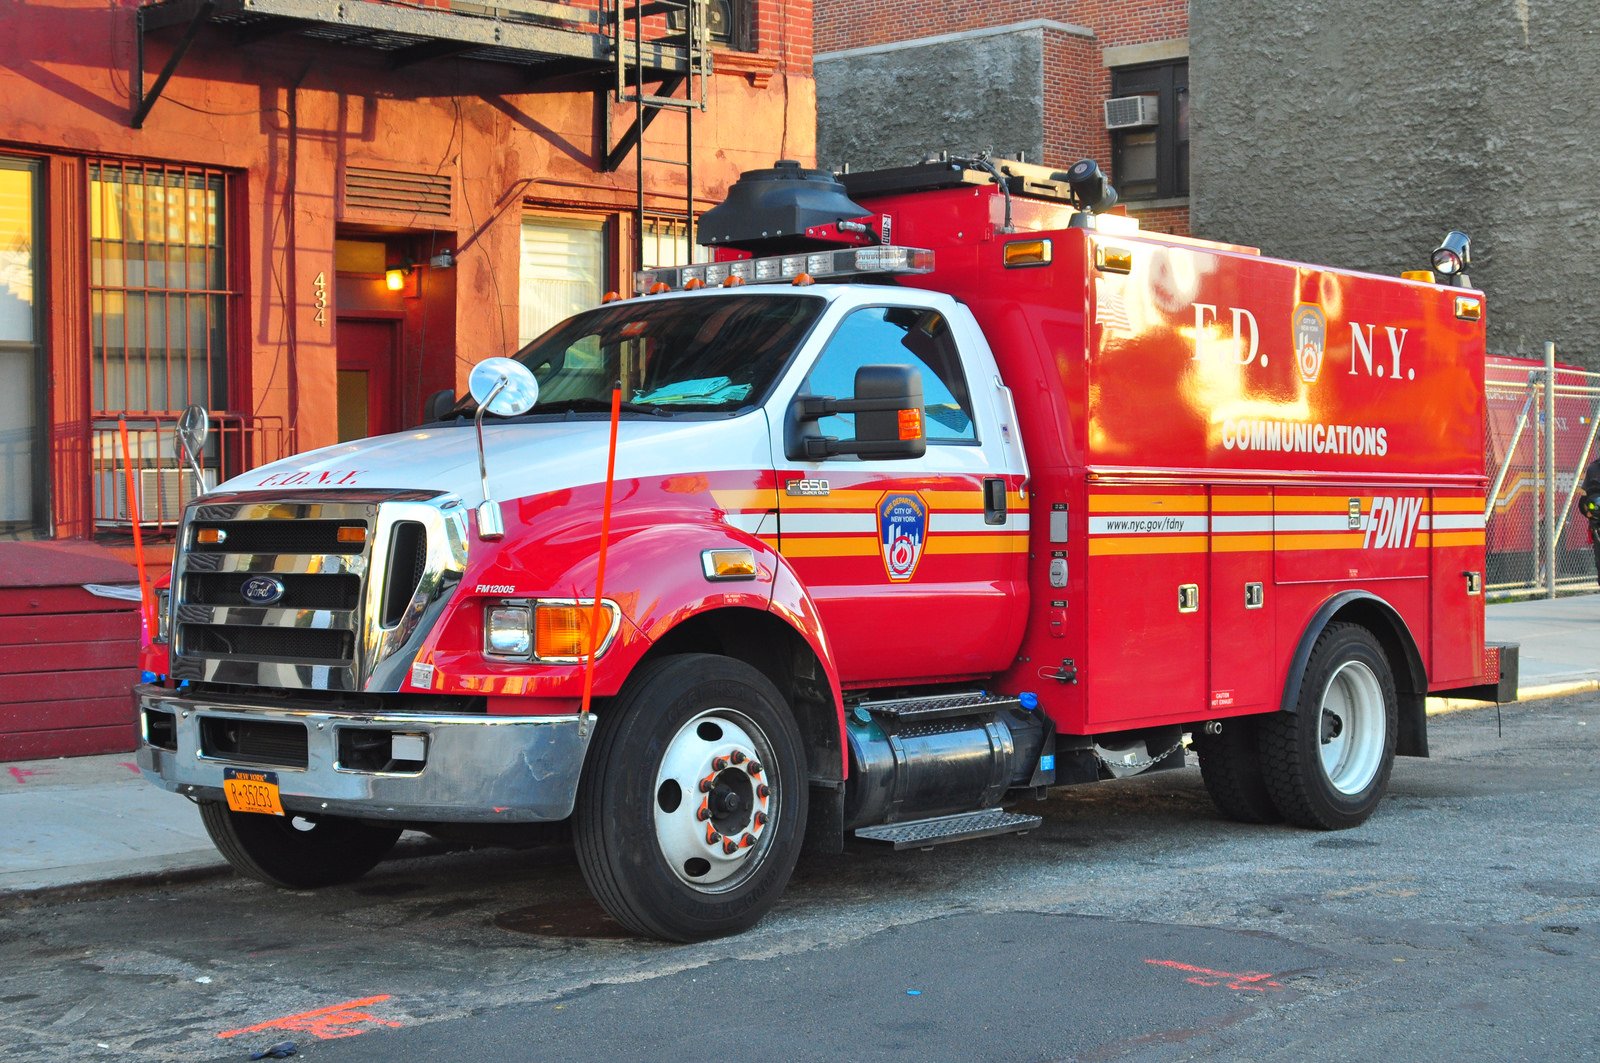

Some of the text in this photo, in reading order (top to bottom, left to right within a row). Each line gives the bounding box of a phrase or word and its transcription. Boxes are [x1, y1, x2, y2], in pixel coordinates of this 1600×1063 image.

[313, 271, 327, 327] 434
[1191, 302, 1268, 368] F.D.
[1348, 321, 1415, 381] N.Y.
[1221, 418, 1388, 456] COMMUNICATIONS
[257, 470, 368, 486] F.D.N.Y.
[884, 497, 922, 518] FIRE DEPARTMENT
[1107, 517, 1184, 532] www.nyc.gov/fdny
[1363, 496, 1423, 549] FDNY
[246, 580, 272, 597] Ford
[475, 584, 516, 594] FM12005
[236, 772, 265, 782] NEW YORK
